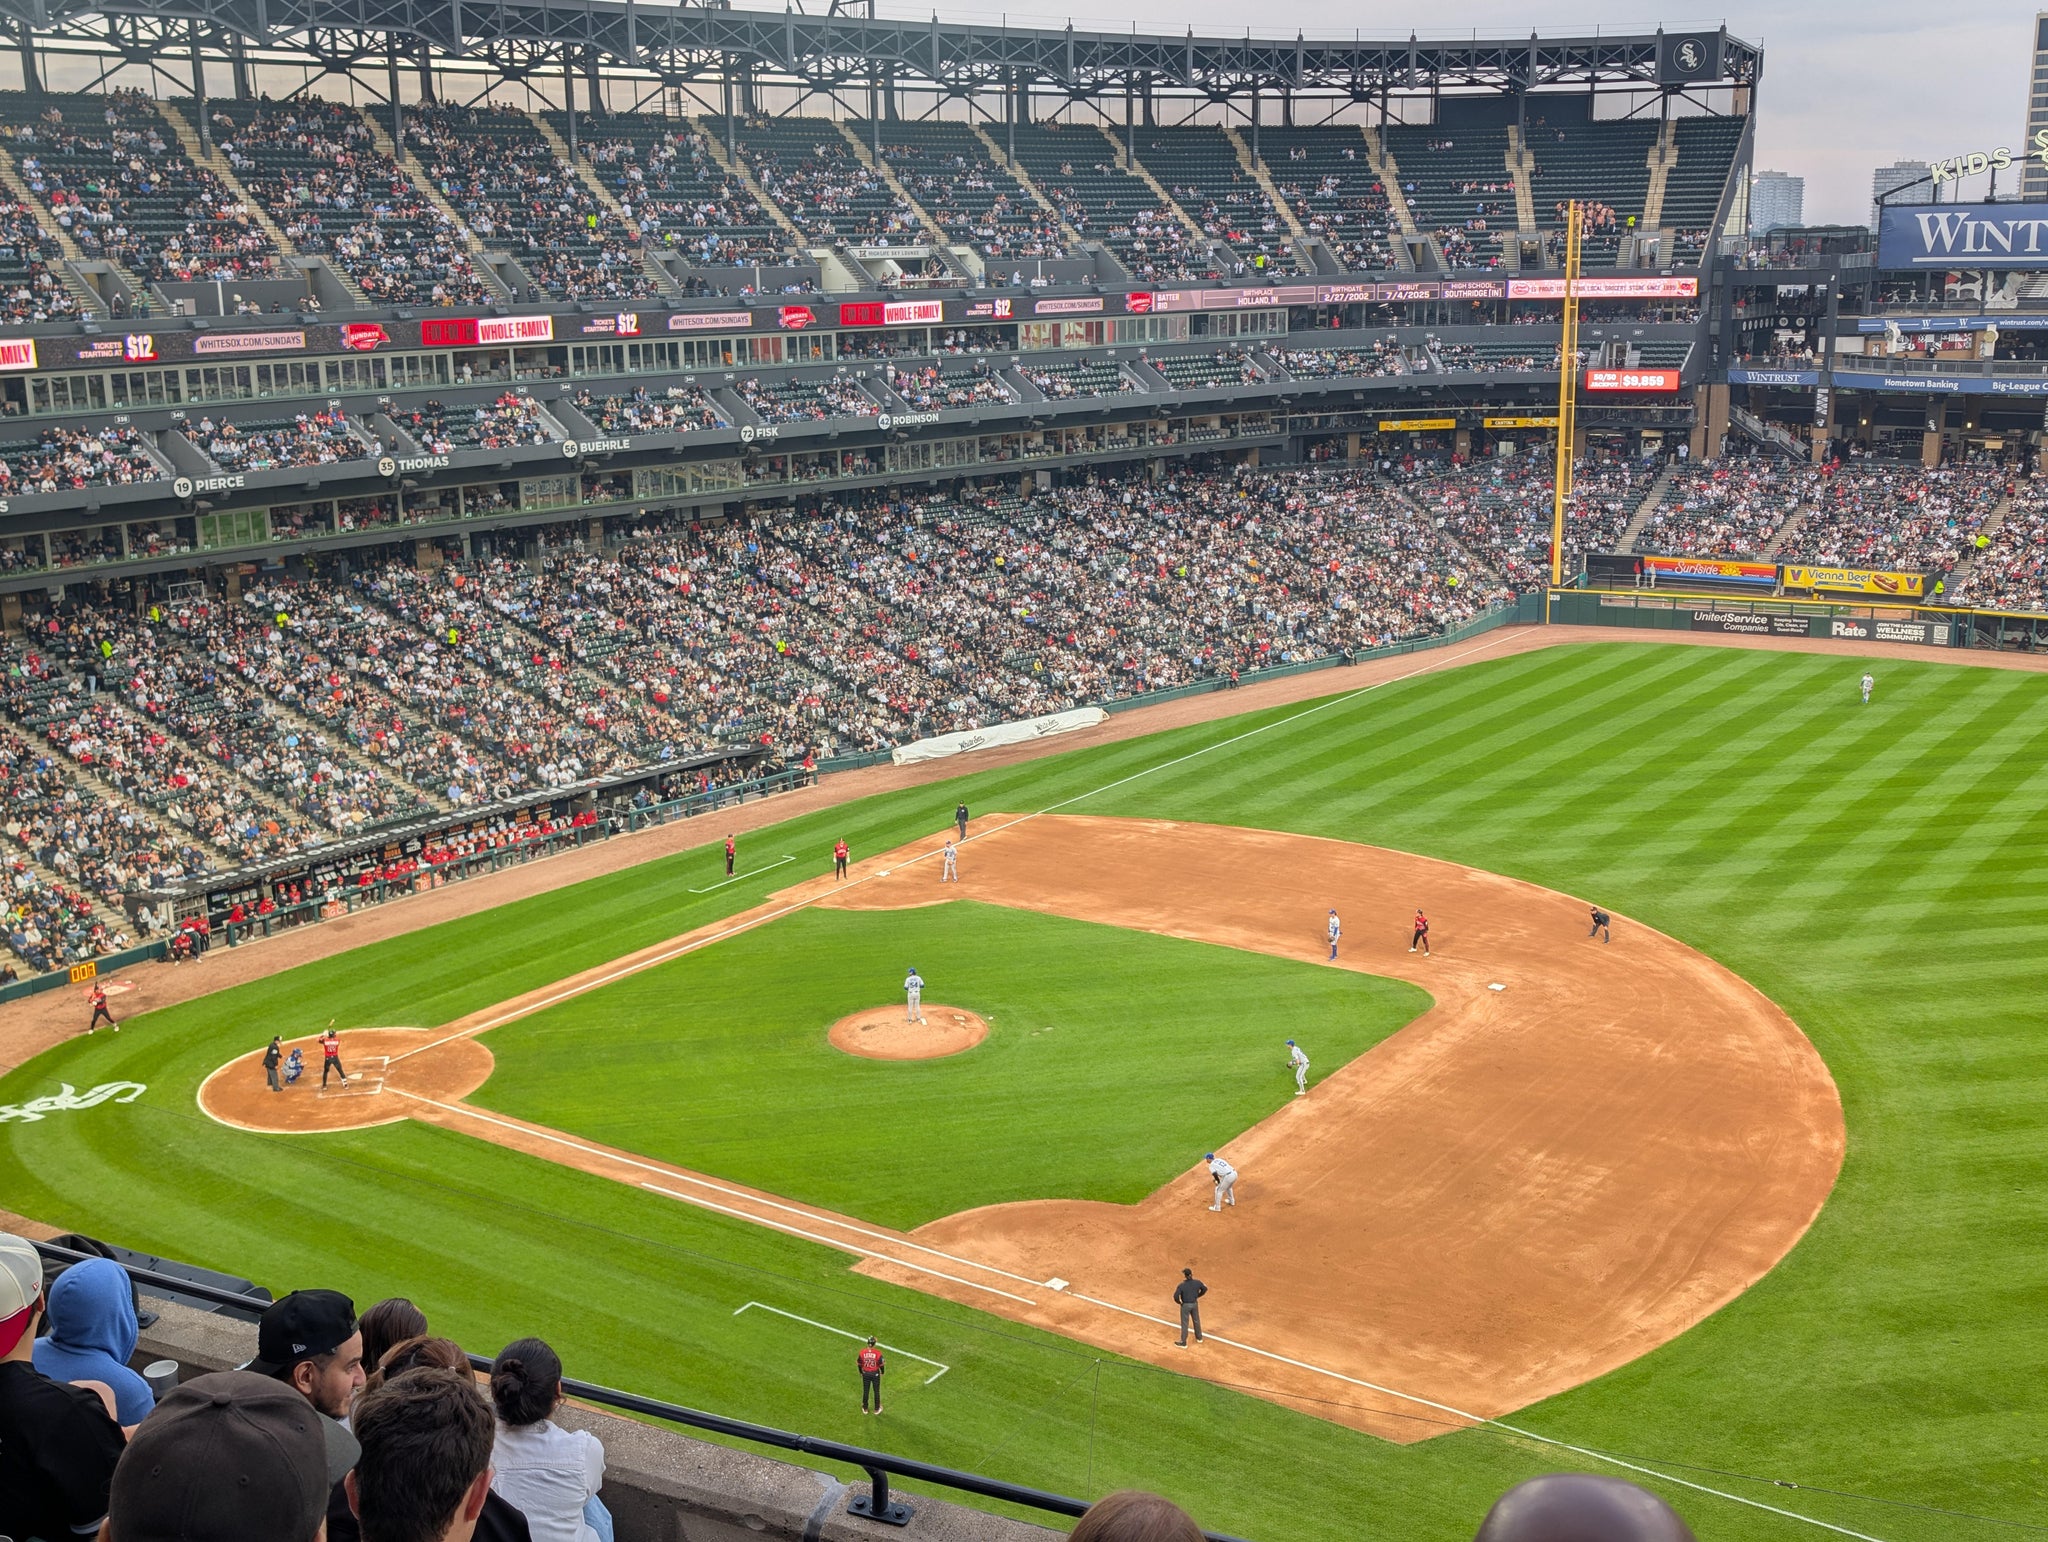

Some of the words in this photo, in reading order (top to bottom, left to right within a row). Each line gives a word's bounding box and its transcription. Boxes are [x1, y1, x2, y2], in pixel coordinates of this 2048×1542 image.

[1930, 147, 2011, 184] KIDS
[1915, 212, 2048, 253] WINT
[1324, 293, 1369, 301] 2/27/2002
[1386, 291, 1430, 299] 7/4/2025
[995, 300, 1011, 317] $12
[1038, 301, 1100, 310] WHITESOX.COM/SUNDAYS
[886, 307, 912, 322] WHOLE
[914, 302, 941, 320] FAMILY
[618, 313, 638, 334] $12
[672, 316, 748, 326] WHITESOX.COM/SUNDAYS
[350, 332, 379, 340] SUNDAYS
[480, 323, 514, 341] WHOLE
[516, 320, 549, 339] FAMILY
[127, 333, 153, 360] $12
[200, 336, 301, 348] WHITESOX.COM/SUNDAYS
[0, 344, 30, 364] MILY
[79, 350, 112, 359] STARTING
[1622, 375, 1664, 387] $9,859
[1747, 372, 1800, 382] WINTRUST
[1885, 379, 1924, 387] Hometown
[1927, 380, 1959, 390] Banking
[1992, 382, 2040, 390] Big-League
[880, 418, 890, 426] 42
[893, 413, 939, 425] ROBINSON
[743, 430, 753, 438] 72
[756, 427, 778, 438] FISK
[565, 445, 576, 453] 56
[580, 439, 630, 453] BUEHRLE
[381, 462, 393, 471] 35
[398, 456, 449, 471] THOMAS
[176, 482, 189, 492] 19
[196, 476, 245, 492] PIERCE
[1674, 561, 1718, 575] Surfside
[1808, 569, 1844, 580] Vienna
[1848, 571, 1872, 582] Beef
[1694, 612, 1768, 624] UnitedService
[1724, 623, 1769, 632] Companies
[1832, 622, 1868, 637] Rate
[1876, 627, 1925, 636] WELLNESS
[1876, 634, 1925, 642] COMMUNITY
[389, 822, 427, 833] THE
[241, 854, 306, 873] WHITE
[196, 872, 239, 884] SOX
